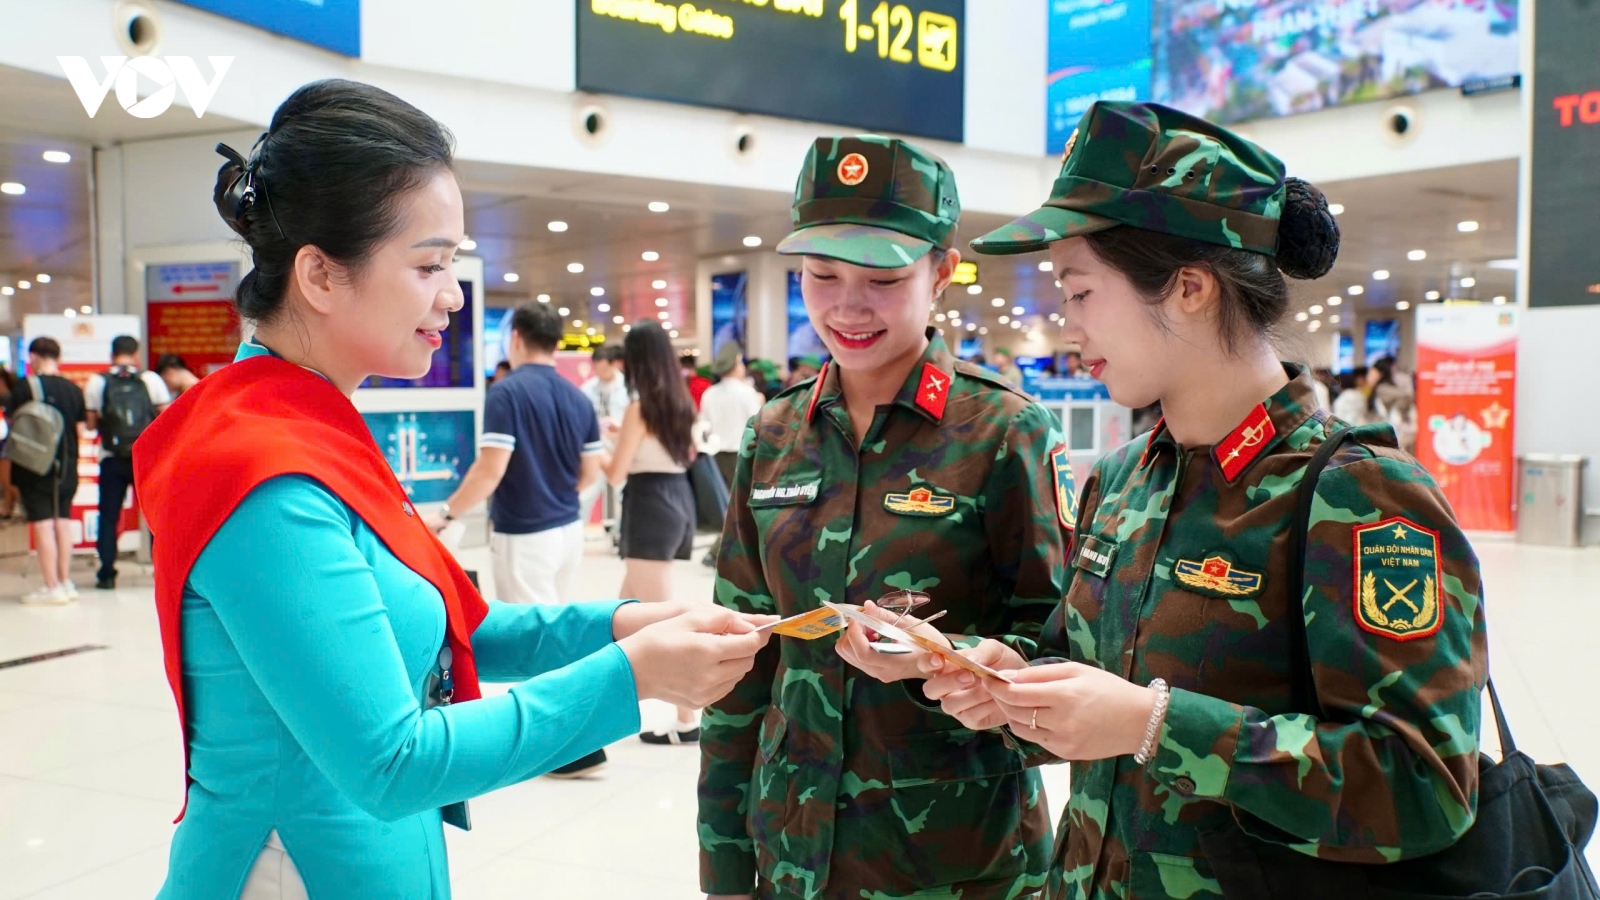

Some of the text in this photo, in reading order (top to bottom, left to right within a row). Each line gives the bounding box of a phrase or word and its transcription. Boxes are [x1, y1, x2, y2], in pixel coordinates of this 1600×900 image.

[678, 3, 734, 39] Gates
[840, 0, 913, 63] 1-12
[1363, 544, 1433, 557] QUÂN ĐỘI NHÂN DÂN
[1381, 556, 1420, 567] VIỆT NAM
